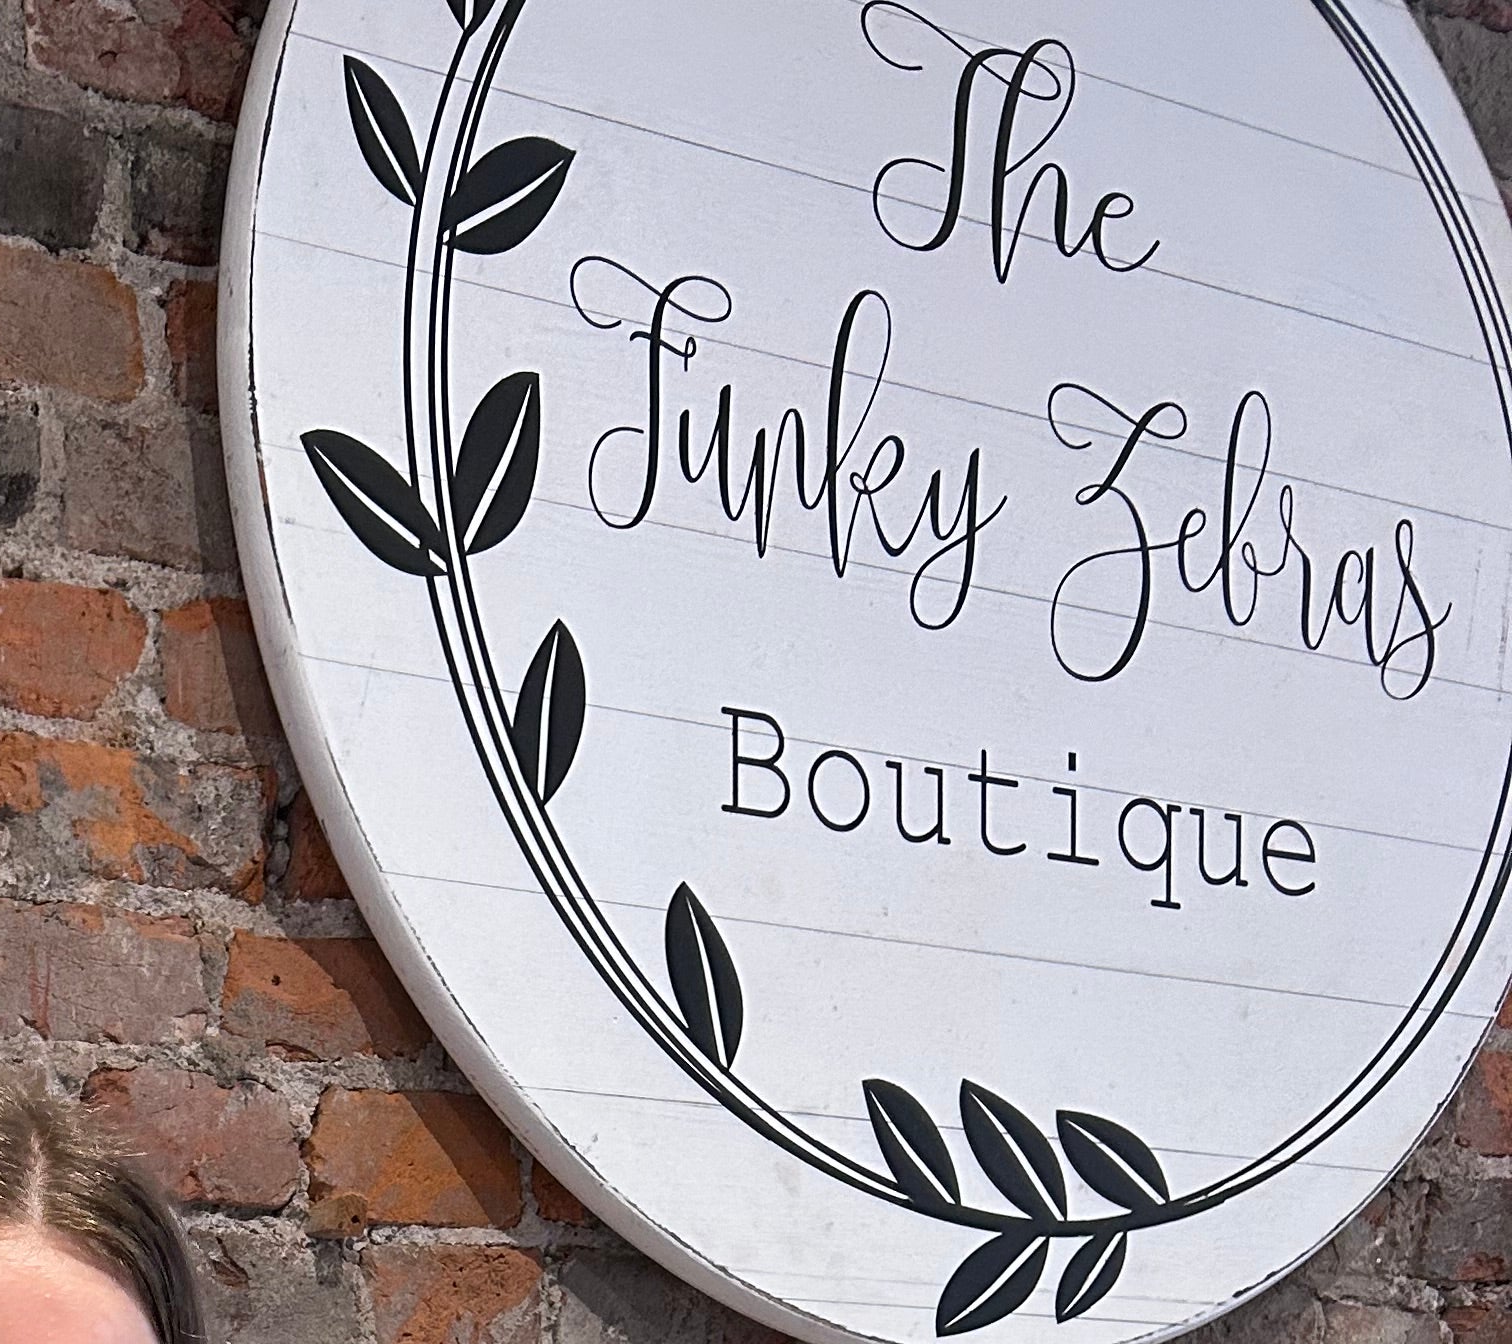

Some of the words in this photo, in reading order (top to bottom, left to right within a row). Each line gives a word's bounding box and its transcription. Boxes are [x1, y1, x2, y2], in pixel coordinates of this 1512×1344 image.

[860, 0, 1161, 285] The
[569, 255, 1008, 631] Funky
[1047, 382, 1453, 701] Zebras
[720, 706, 1317, 910] Boutique
